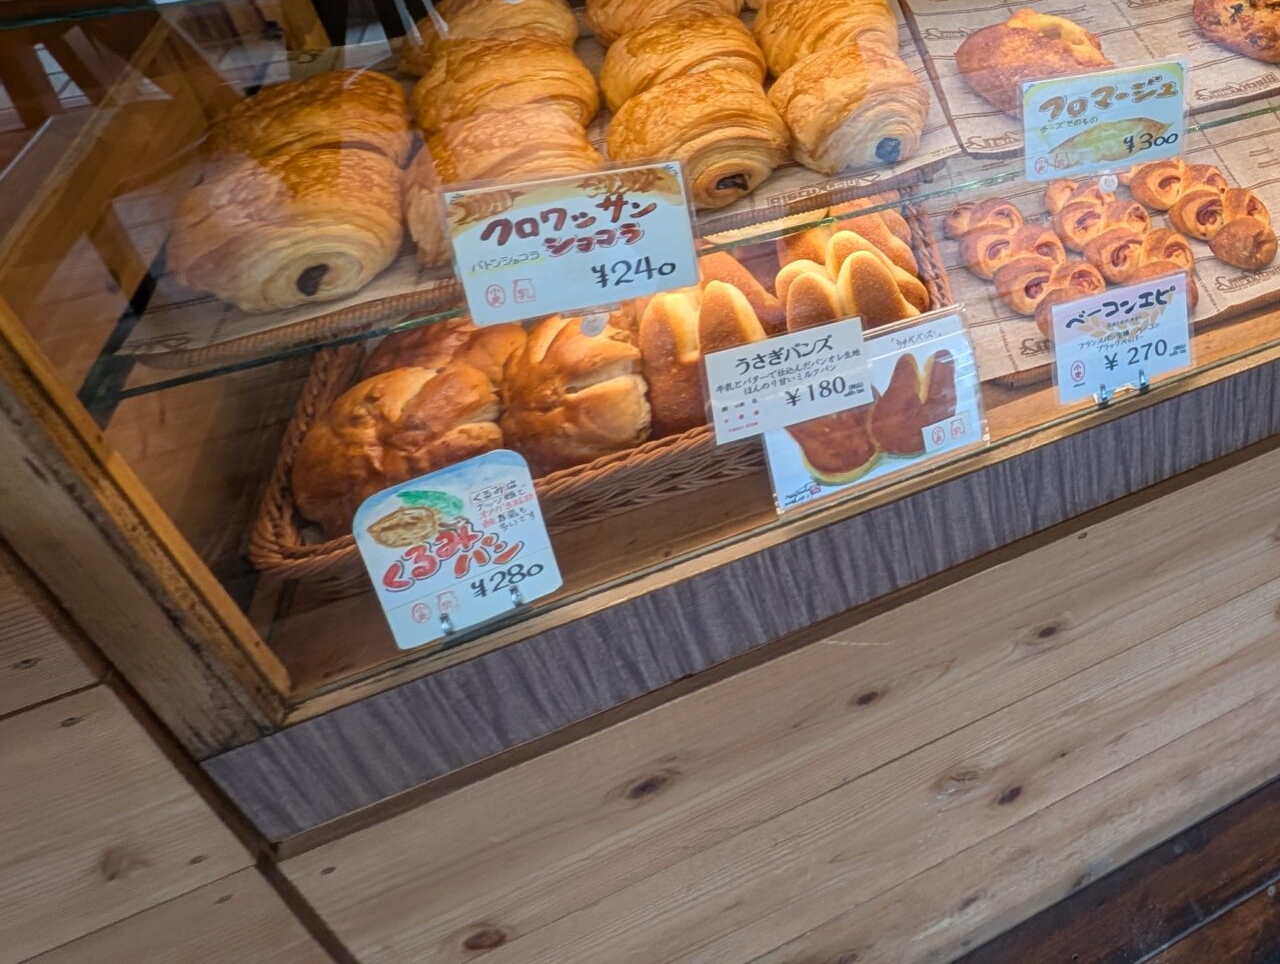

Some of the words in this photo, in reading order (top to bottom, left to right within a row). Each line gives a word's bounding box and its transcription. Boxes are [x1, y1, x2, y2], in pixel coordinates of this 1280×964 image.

[1038, 75, 1179, 122] フロマージュ
[1123, 132, 1179, 154] ¥300
[480, 194, 658, 247] クロワッサン
[544, 221, 646, 258] ショコラ
[470, 249, 541, 274] バトンショコラ
[591, 255, 677, 289] ¥240
[1065, 286, 1177, 329] ベーコンエピ
[735, 334, 834, 376] うさぎバンズ
[1103, 338, 1168, 372] ¥270
[785, 375, 846, 408] ¥180
[382, 516, 484, 592] くるみ
[454, 532, 525, 580] パン
[470, 563, 545, 598] ¥280
